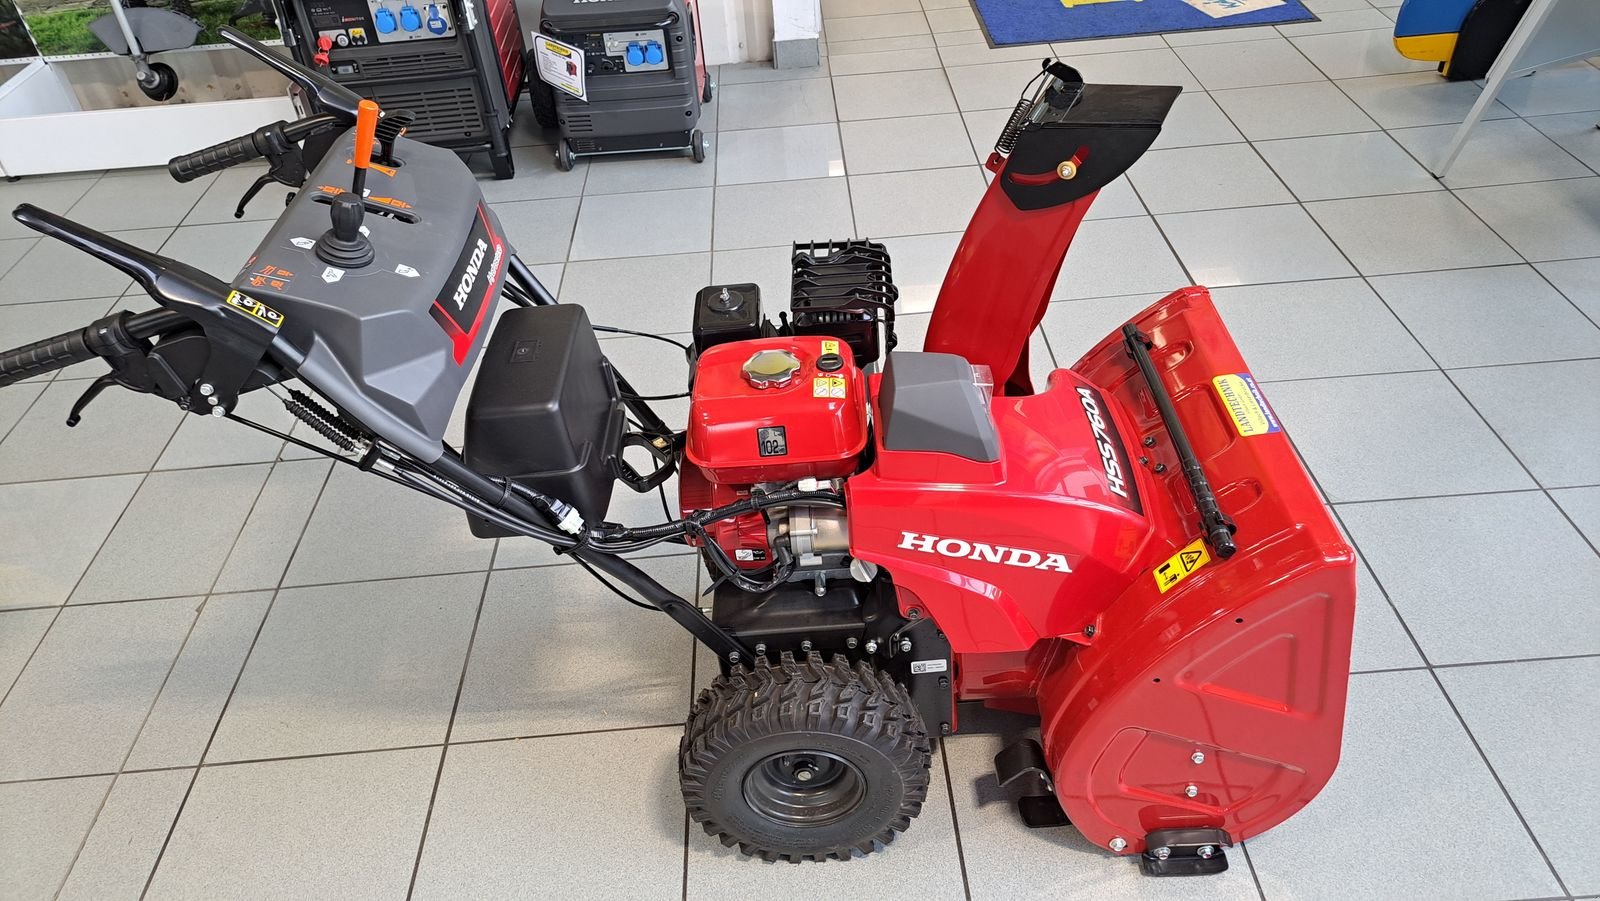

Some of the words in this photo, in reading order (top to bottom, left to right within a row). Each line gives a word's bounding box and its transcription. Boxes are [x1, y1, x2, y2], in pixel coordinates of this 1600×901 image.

[453, 238, 488, 311] HONDA
[1216, 378, 1254, 433] LANDTECHNIK
[761, 439, 779, 455] 102
[1075, 386, 1128, 498] HSS760A
[897, 531, 1073, 573] HONDA
